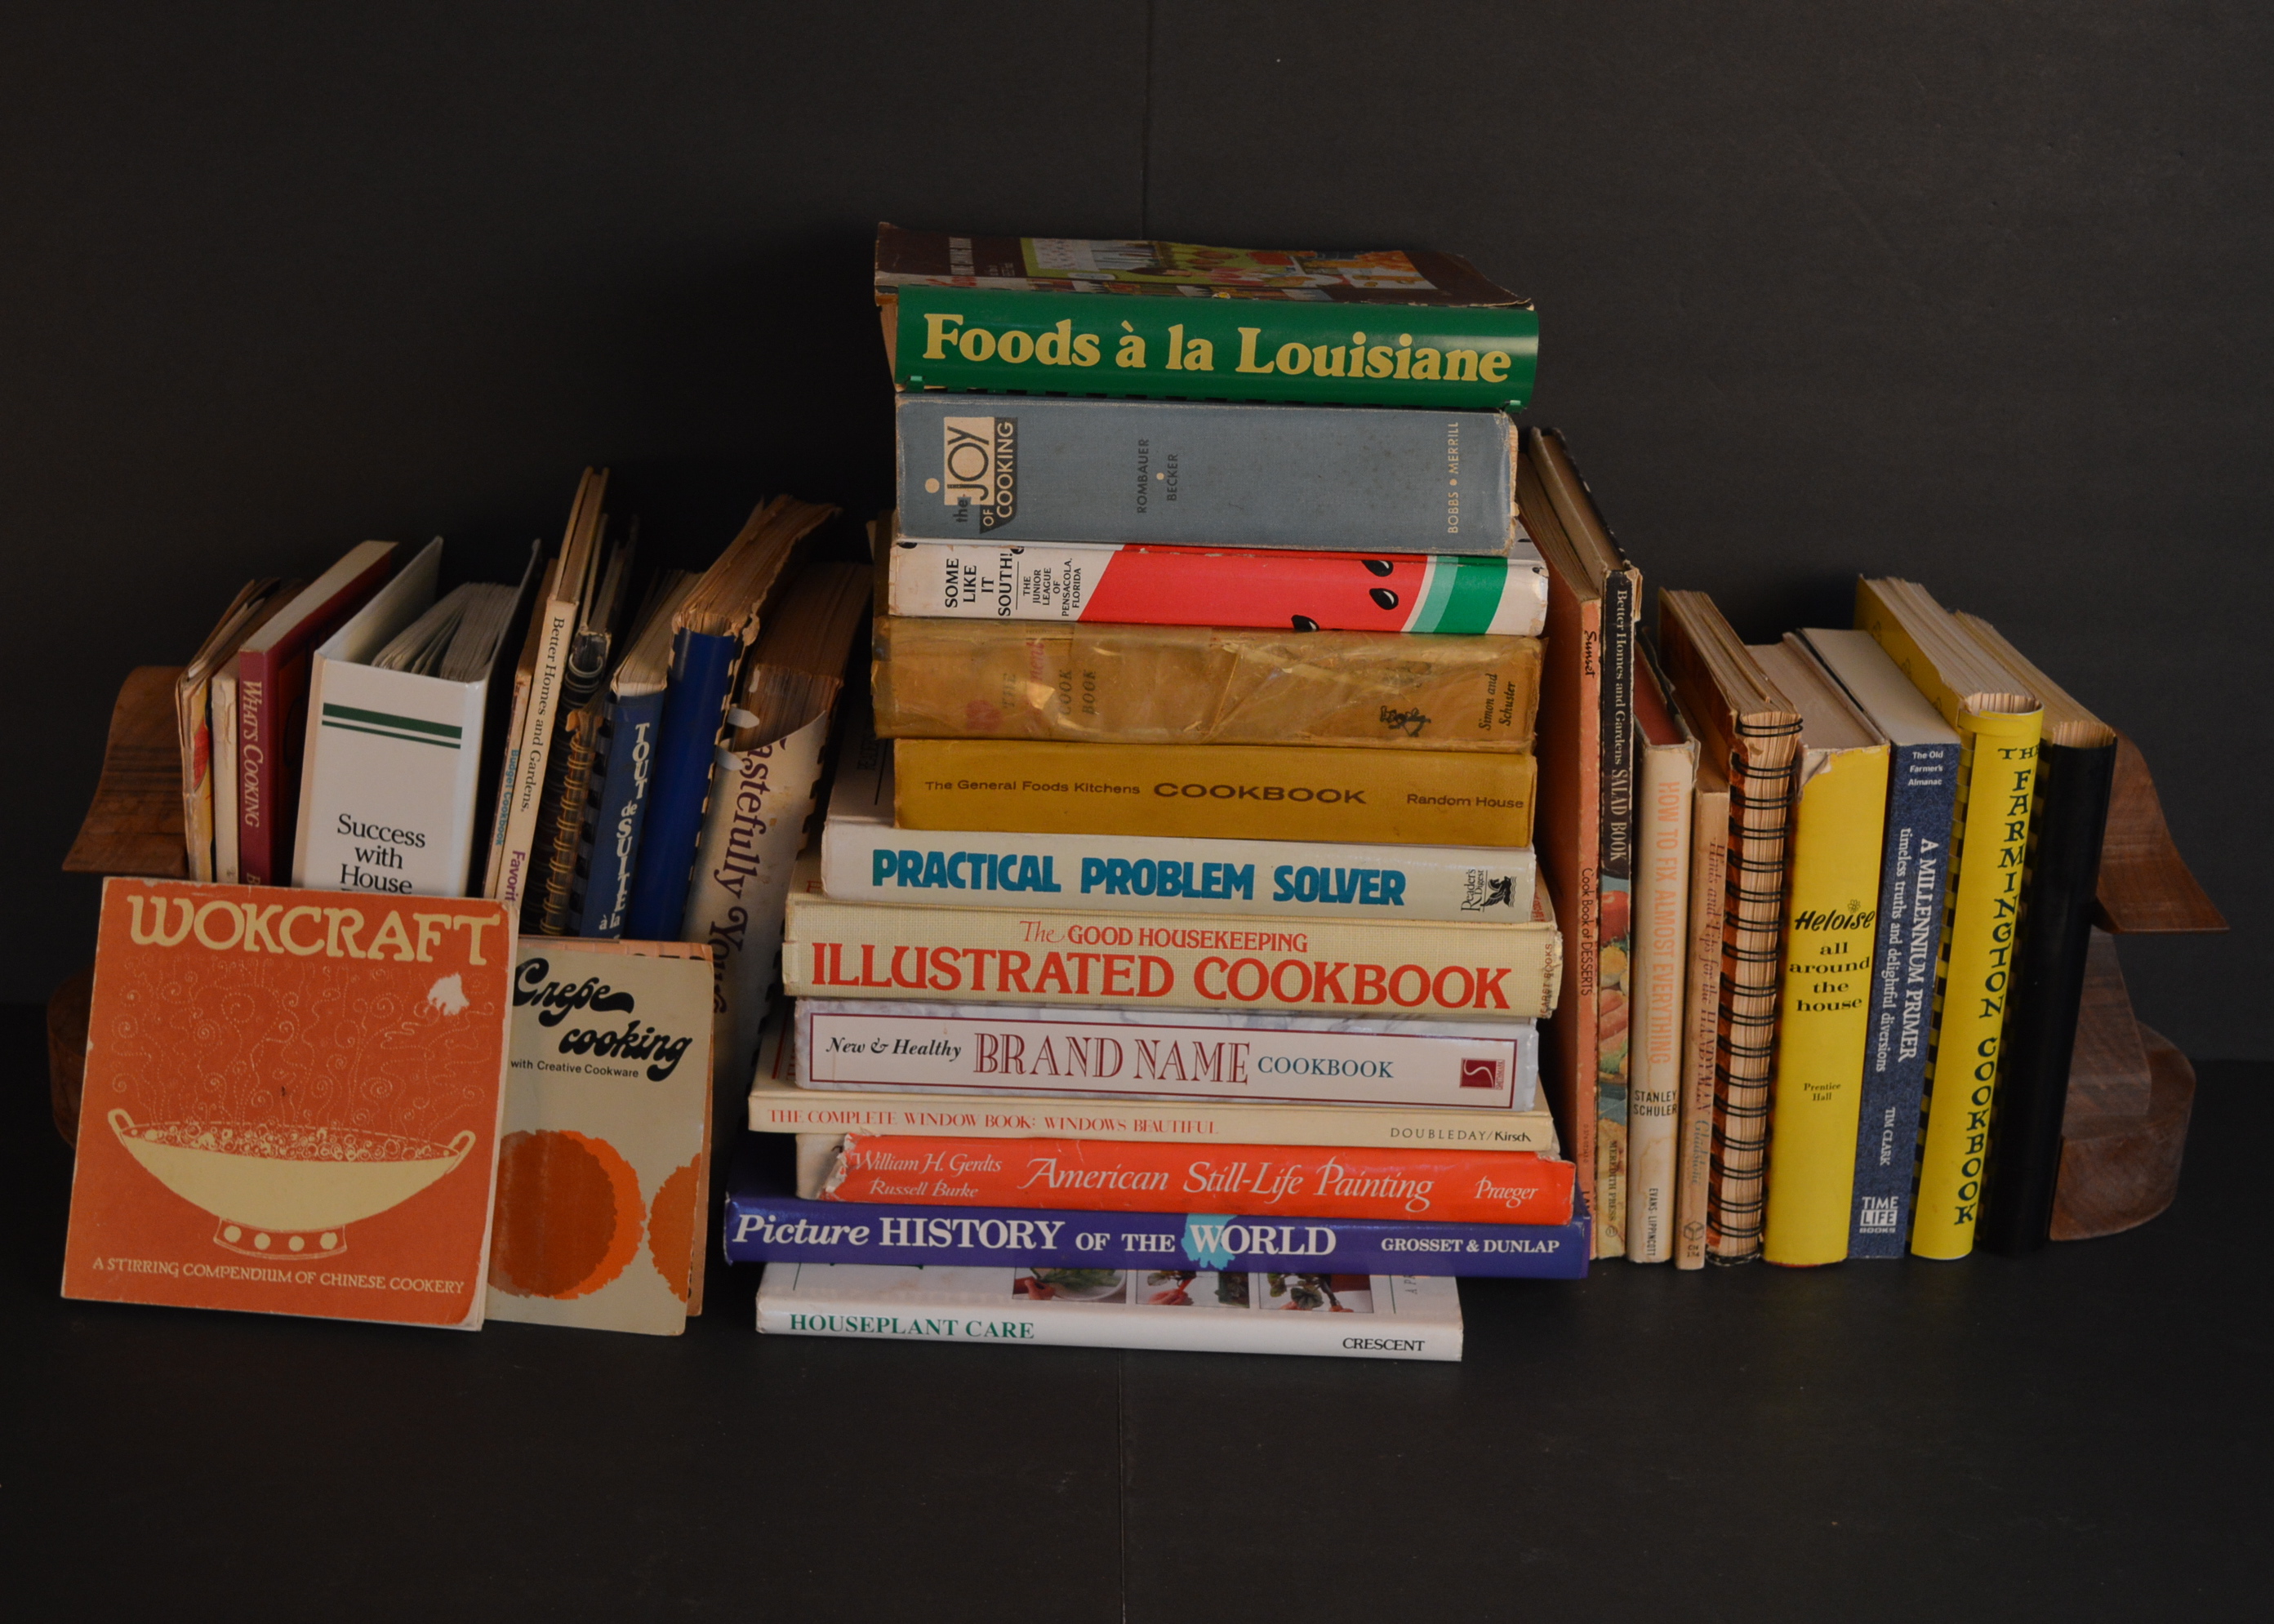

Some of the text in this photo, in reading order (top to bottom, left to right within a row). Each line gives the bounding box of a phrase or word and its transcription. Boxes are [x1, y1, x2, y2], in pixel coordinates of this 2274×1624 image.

[923, 314, 1512, 384] Foods à la Louisiane
[946, 425, 990, 523] the JOY
[982, 420, 1014, 527] OF COOKING
[1137, 438, 1150, 514] ROMBAUER
[1166, 453, 1178, 501] BECKER
[1447, 421, 1459, 534] BOBBS MERRILL
[944, 558, 959, 608] SOME
[963, 565, 977, 603] LIKE
[981, 576, 995, 594] IT
[998, 551, 1013, 616] SOUTH!
[1022, 576, 1031, 597] THE
[1032, 569, 1042, 604] JUNIOR
[1042, 567, 1052, 606] LEAGUE
[1052, 580, 1061, 594] OF
[1071, 567, 1082, 608] FLORIDA
[549, 616, 565, 663] Better
[1583, 630, 1598, 679] Sunset
[537, 663, 558, 717] Homes
[1082, 670, 1097, 716] BOOK
[1479, 672, 1498, 732] Simon and
[1498, 681, 1517, 727] Schuster
[532, 718, 545, 746] and
[1610, 589, 1628, 861] Better Homes and Gardens SALAD BOOK
[1909, 763, 1944, 774] Farmer's
[1911, 750, 1944, 760] The Old
[1997, 742, 2040, 760] THE
[243, 744, 264, 828] COOKING
[495, 749, 520, 846] Budget Cookbook
[925, 780, 1524, 809] The General Foods Kitchens COOKBOOK Random House
[1907, 777, 1943, 787] Almanac
[337, 812, 426, 848] Success
[613, 722, 651, 913] TOUT de SUITE
[713, 738, 788, 900] astefully
[354, 844, 403, 870] with
[872, 848, 1406, 906] PRACTICAL PROBLEM SOLVER
[340, 862, 413, 895] House
[1460, 869, 1481, 912] Reader's
[1473, 869, 1484, 896] Digest
[127, 894, 501, 966] WOKCRAFT
[1019, 920, 1308, 954] The GOOD HOUSEKEEPING
[1581, 867, 1595, 996] Cook Book DESSERTS
[1649, 781, 1680, 1064] HOW TO FIX ALMOST EVERYTHING
[1794, 908, 1876, 932] Heloise
[1789, 956, 1871, 974] around
[1819, 941, 1849, 956] all
[1876, 826, 1913, 1073] timeless truths and delightful diversions
[1898, 837, 1939, 1063] A MILLENNIUM PRIMER
[812, 941, 1513, 1010] ILLUSTRATED COOKBOOK
[1696, 842, 1725, 1115] Hints and Tips HANDYMAN
[1813, 981, 1849, 994] the
[1796, 998, 1862, 1012] house
[1953, 768, 2032, 1226] FARMINGTON COOKBOOK
[510, 1060, 639, 1078] with Creative Cookware
[558, 1020, 693, 1082] cooking
[825, 1033, 1395, 1086] New & Healthy BRAND NAME COOKBOOK
[1634, 1089, 1678, 1103] STANLEY
[1803, 1082, 1842, 1092] Prentice
[1812, 1092, 1833, 1102] Hall
[767, 1109, 804, 1123] THE
[807, 1110, 897, 1125] COMPLETE
[904, 1112, 980, 1127] WINDOW
[984, 1115, 1037, 1129] BOOK:
[1044, 1116, 1128, 1132] WINDOWS
[1133, 1119, 1219, 1135] BEAUTIFUL
[1633, 1103, 1678, 1117] SCHULER
[1880, 1106, 1896, 1167] TIM CLARK
[851, 1150, 1003, 1174] William H. Gerdts
[1608, 1140, 1618, 1221] MEREDITH PRESS
[870, 1179, 980, 1199] Russell Burke
[1017, 1157, 1168, 1191] American
[1182, 1160, 1304, 1205] Still-Life
[1312, 1155, 1435, 1213] Painting
[1473, 1174, 1539, 1209] Praeger
[1861, 1195, 1899, 1210] TIME
[732, 1213, 1560, 1256] Picture HISTORY OF THE WORLD GROSSET & DUNLAP
[1646, 1215, 1658, 1257] LIPPINCOTT
[1862, 1211, 1896, 1225] LIFE
[92, 1257, 465, 1297] A STIRRING COMPENDIUM OF CHINESE COOKERY
[790, 1314, 1426, 1352] HOUSEPLANT CARE CRESCENT
